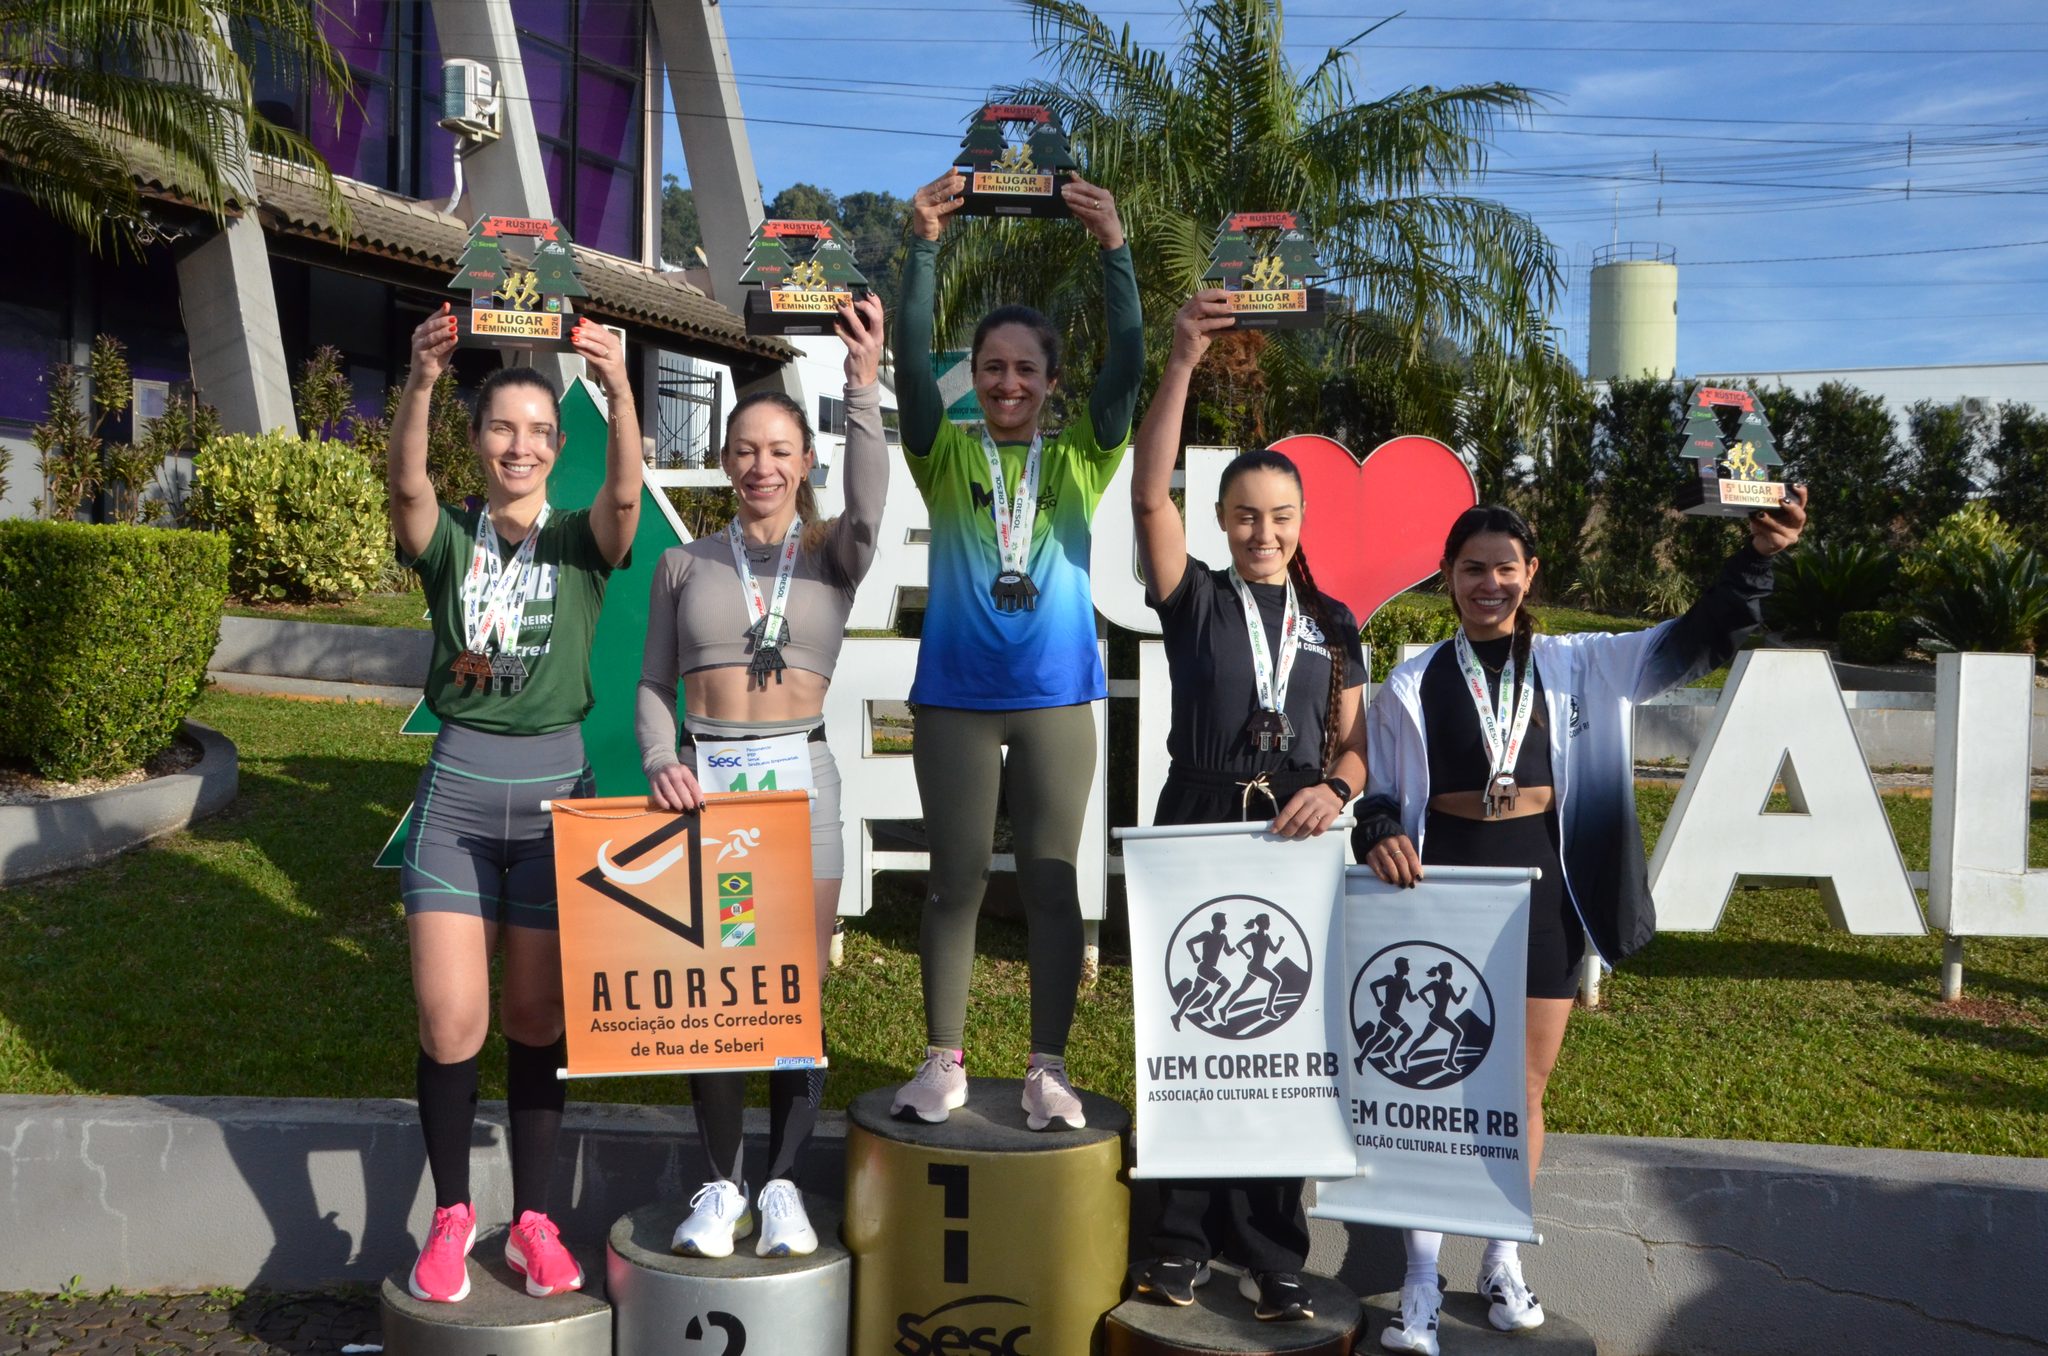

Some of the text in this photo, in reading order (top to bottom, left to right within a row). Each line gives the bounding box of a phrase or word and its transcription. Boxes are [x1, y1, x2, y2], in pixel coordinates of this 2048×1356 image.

[976, 184, 1043, 194] FEMININO 3KM
[995, 176, 1037, 186] LUGAR
[505, 219, 549, 231] RÚSTICA
[793, 294, 837, 304] LUGAR
[1248, 293, 1291, 303] LUGAR
[775, 302, 821, 311] FEMININO
[1276, 302, 1297, 311] 3KM
[479, 312, 544, 327] 4º LUGAR
[476, 323, 550, 337] FEMININO 3KM
[995, 475, 1005, 505] CRESOL
[1737, 484, 1773, 496] LUGAR
[1724, 493, 1761, 504] FEMININO
[1013, 498, 1023, 530] CRESOL
[777, 573, 788, 599] CRESOL
[1518, 688, 1530, 719] CRESOL
[707, 755, 743, 768] Sesc
[592, 964, 801, 1012] ACORSEB
[590, 1010, 803, 1035] Associação dos Corredores
[630, 1036, 765, 1057] de Rua de Seberi
[1147, 1052, 1340, 1081] VEM CORRER RB
[1147, 1086, 1341, 1103] ASSOCIAÇÃO CULTURAL E ESPORTIVA
[1352, 1099, 1520, 1138] EM CORRER RB
[1395, 1137, 1449, 1155] CULTURAL
[1451, 1143, 1458, 1155] E
[1459, 1143, 1520, 1161] ESPORTIVA
[928, 1163, 969, 1284] 1
